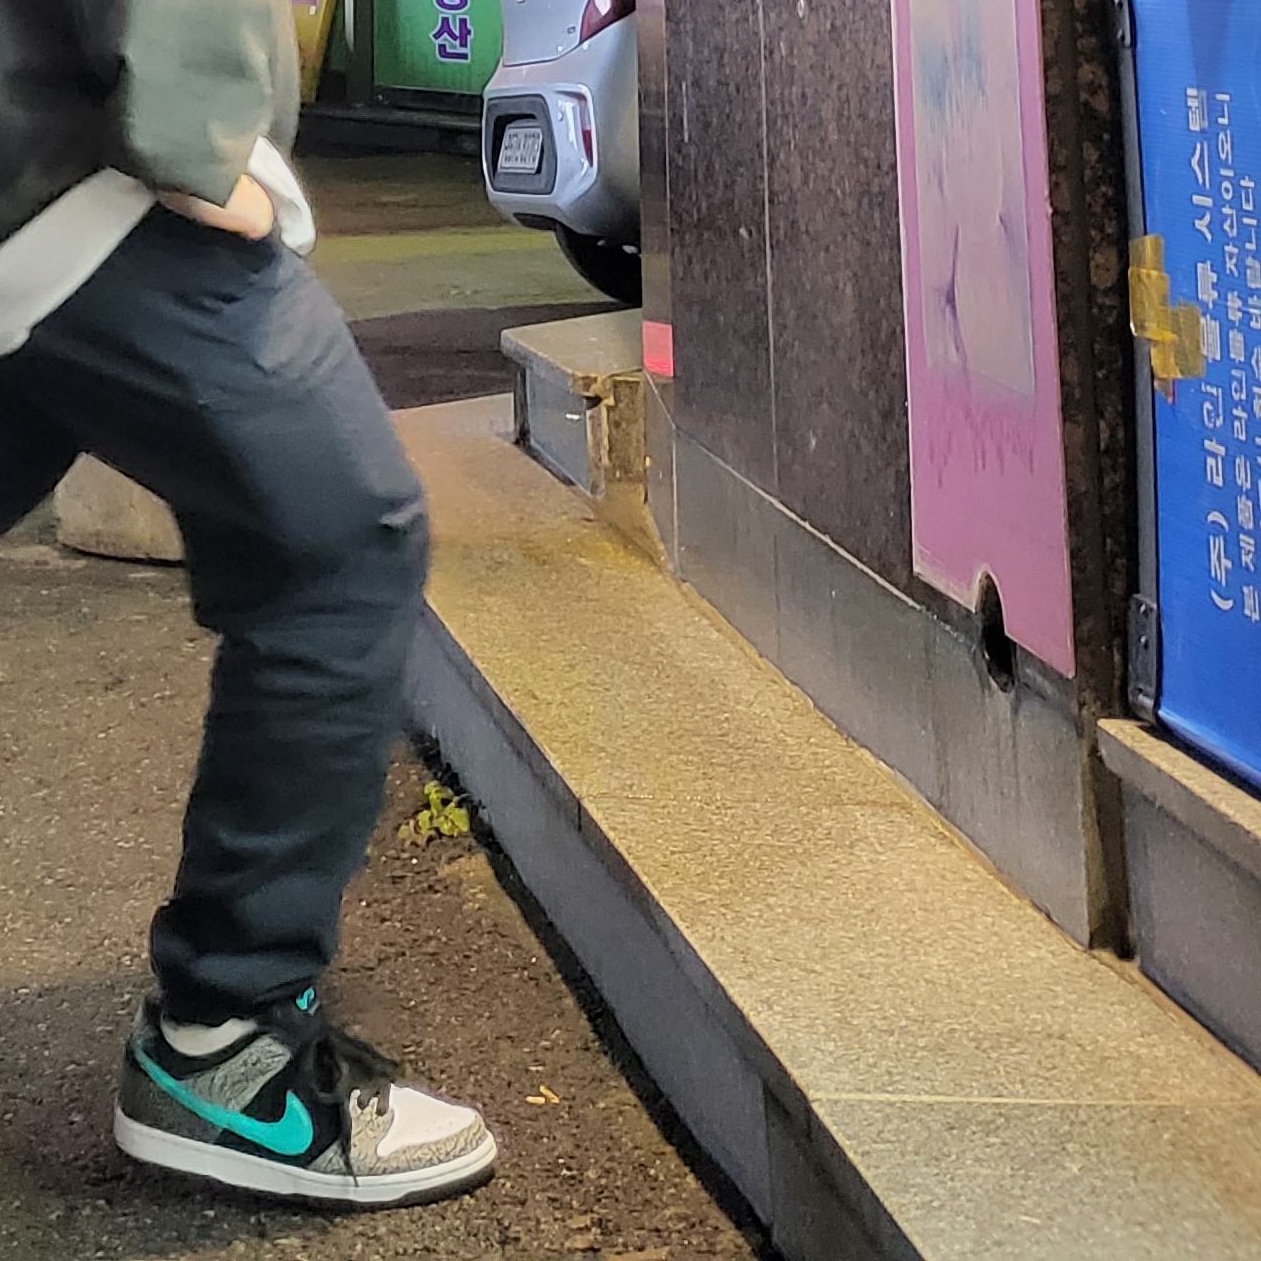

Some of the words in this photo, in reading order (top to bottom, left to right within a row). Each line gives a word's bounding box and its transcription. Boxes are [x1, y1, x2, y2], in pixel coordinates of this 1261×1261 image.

[1185, 87, 1213, 243] 시스템
[1215, 93, 1239, 277] 자산이오니
[1202, 382, 1226, 487] 라인
[1206, 511, 1234, 610] (주)
[1234, 455, 1255, 572] 제품은
